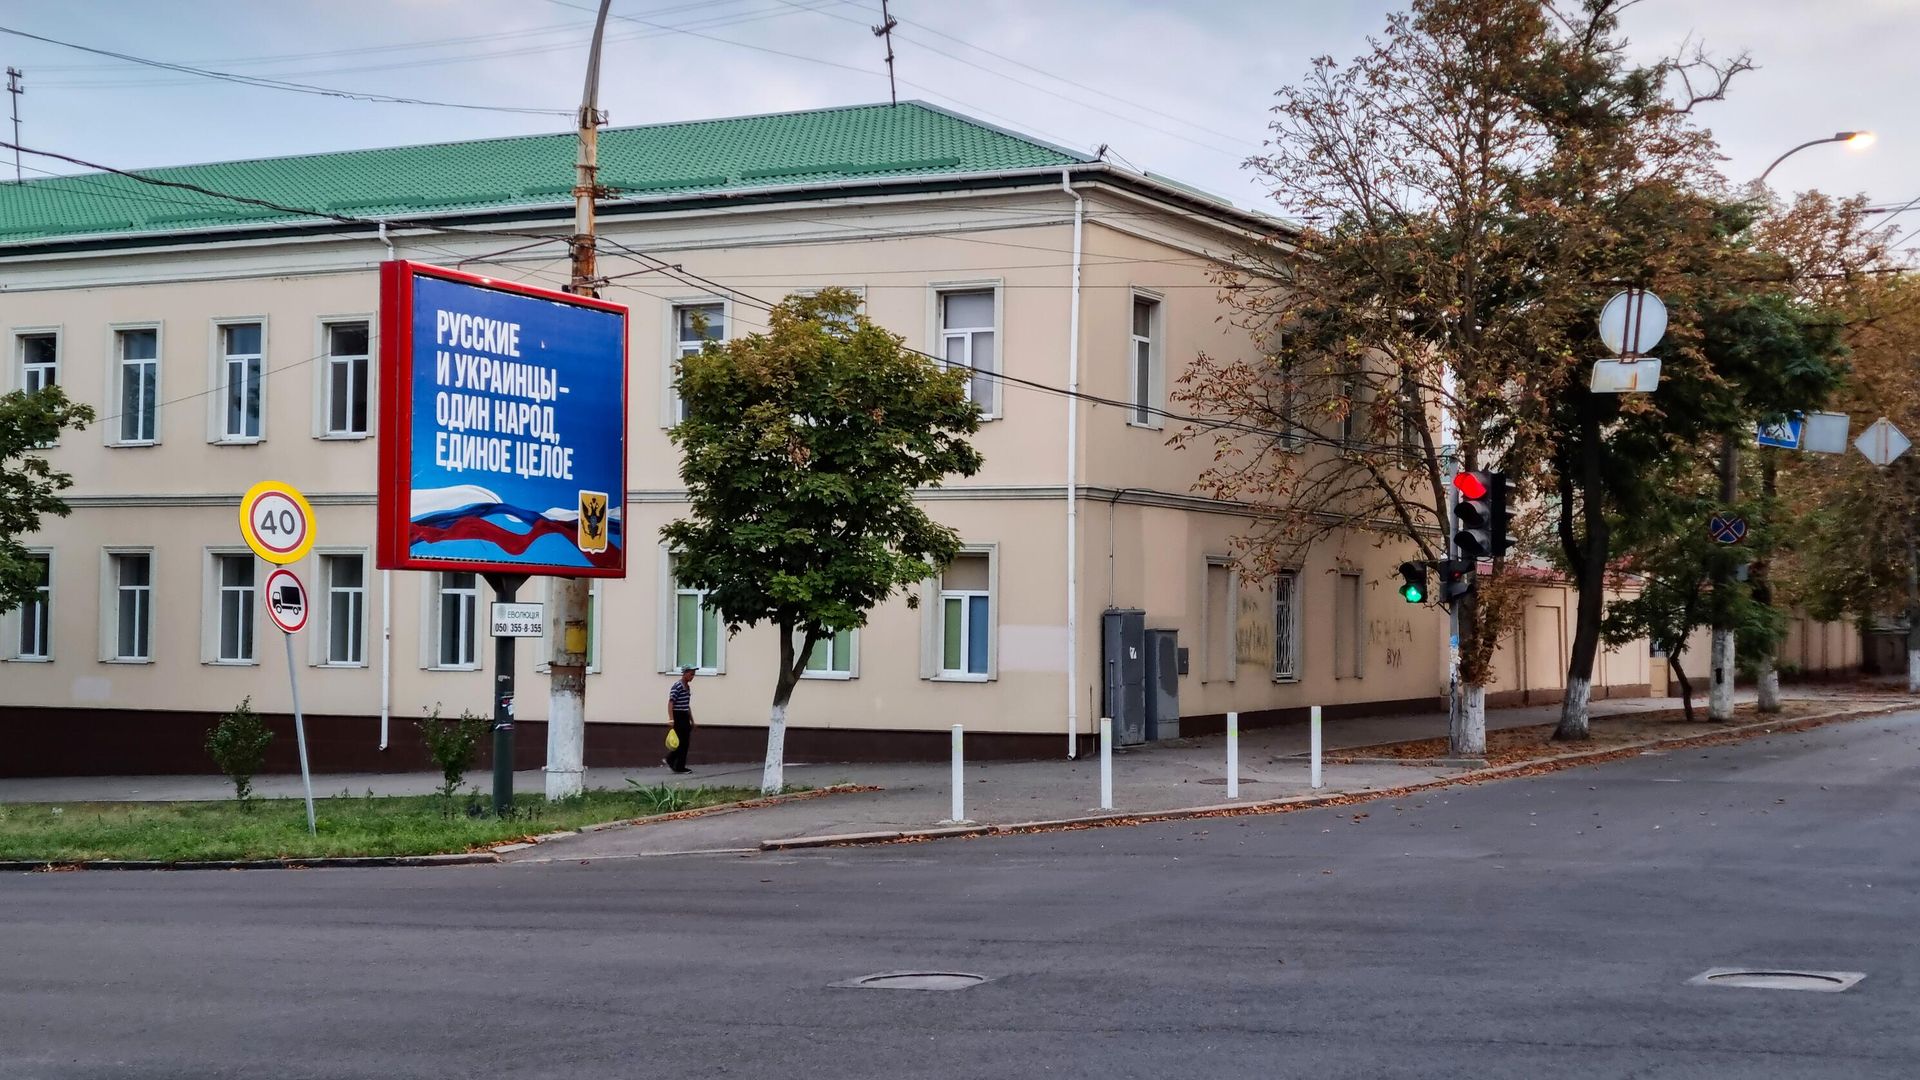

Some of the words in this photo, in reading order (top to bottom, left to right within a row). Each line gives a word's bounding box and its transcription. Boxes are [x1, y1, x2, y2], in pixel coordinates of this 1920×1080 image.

[436, 309, 521, 357] РУССКИЕ
[436, 350, 450, 387] И
[436, 391, 490, 433] ОДИН
[494, 400, 560, 445] НАРОД,
[435, 431, 512, 473] ЕДИНОЕ
[515, 441, 574, 480] ЦЕЛОЕ
[260, 509, 296, 536] 40
[494, 622, 507, 633] 050
[510, 623, 542, 633] 355-8-355
[507, 610, 540, 620] ЕВОЛЮЦІЯ
